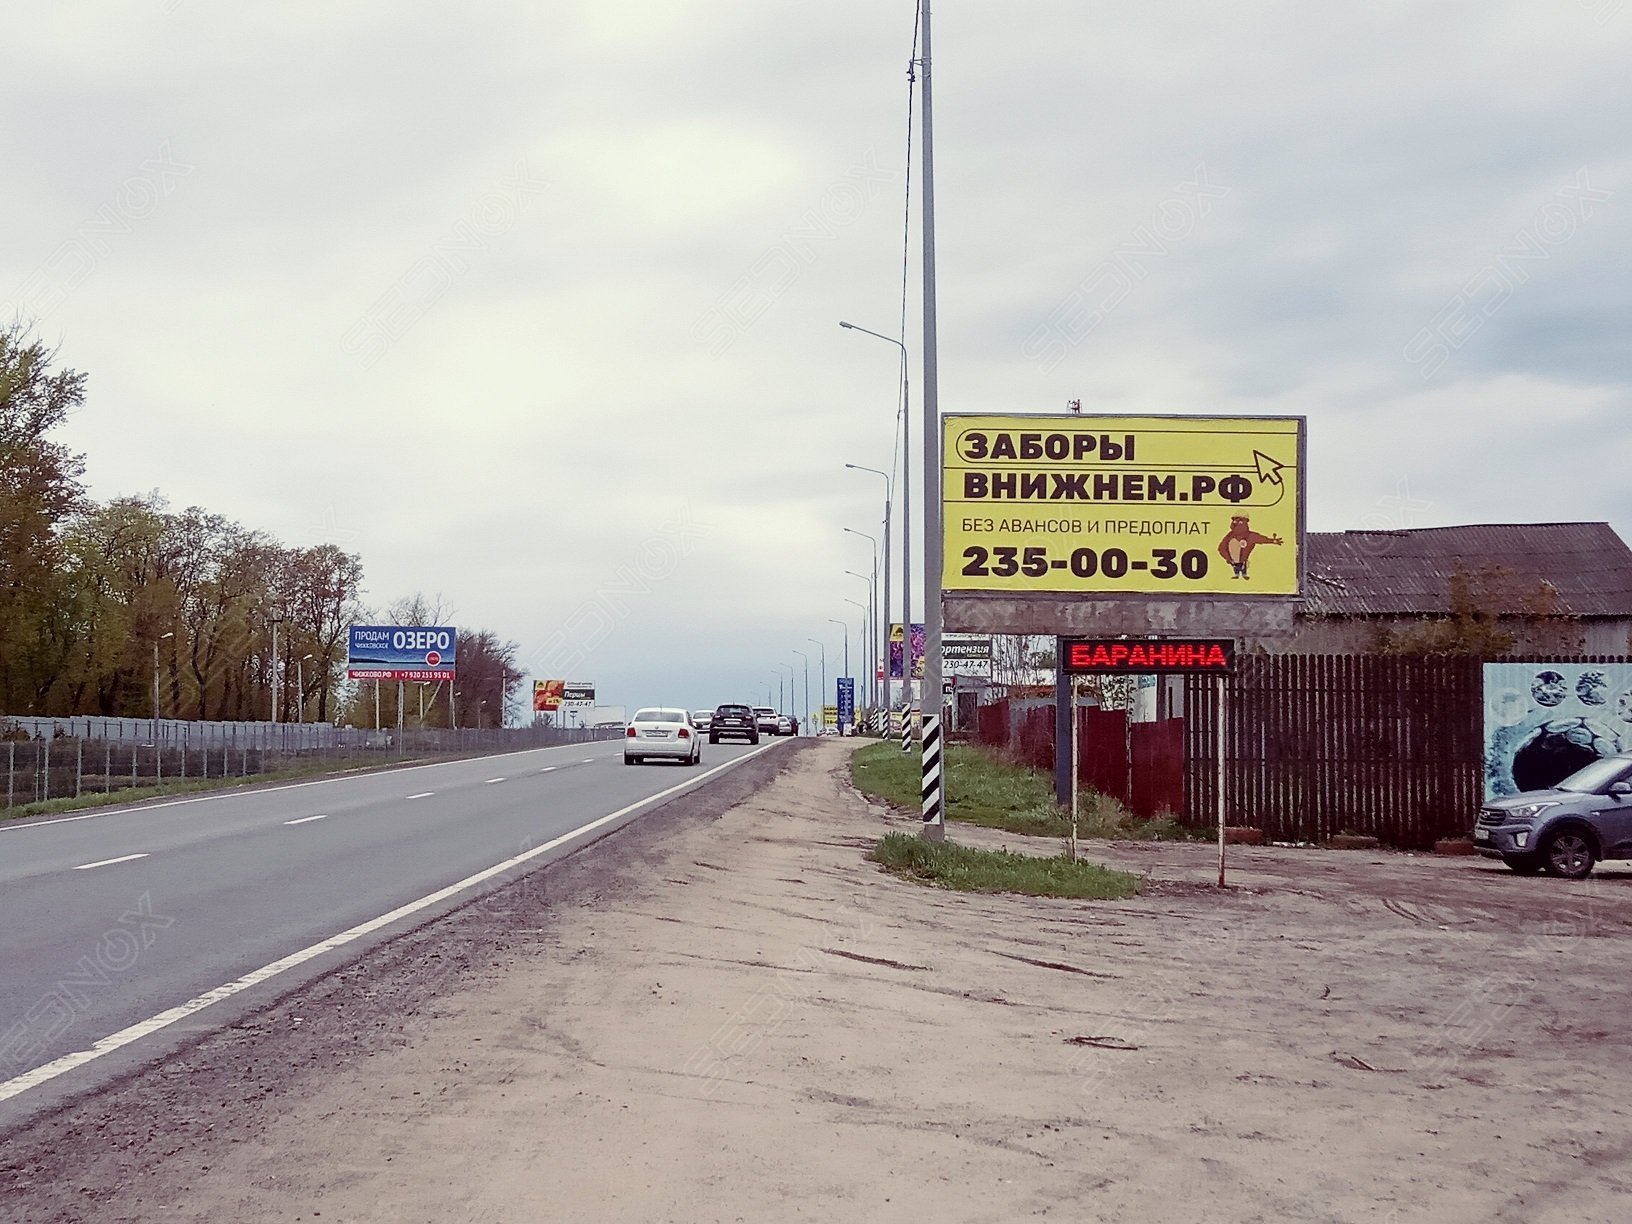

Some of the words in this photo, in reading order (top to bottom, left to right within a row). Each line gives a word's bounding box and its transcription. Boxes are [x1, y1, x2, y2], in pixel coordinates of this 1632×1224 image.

[963, 432, 1135, 461] ЗАБОРЫ
[963, 472, 1253, 503] ВНИЖНЕМ.РФ
[962, 518, 994, 532] БЕЗ
[999, 519, 1082, 533] АВАНСОВ
[1087, 520, 1100, 533] И
[1105, 520, 1210, 536] ПРЕДОПЛАТ
[962, 546, 1209, 579] 235-00-30
[354, 631, 389, 642] ПРОДАМ
[393, 631, 450, 649] ОЗЕРО
[943, 660, 989, 669] 230-47-47
[1071, 644, 1227, 666] БАРАНИНА
[409, 671, 421, 679] 920
[442, 671, 450, 679] 01
